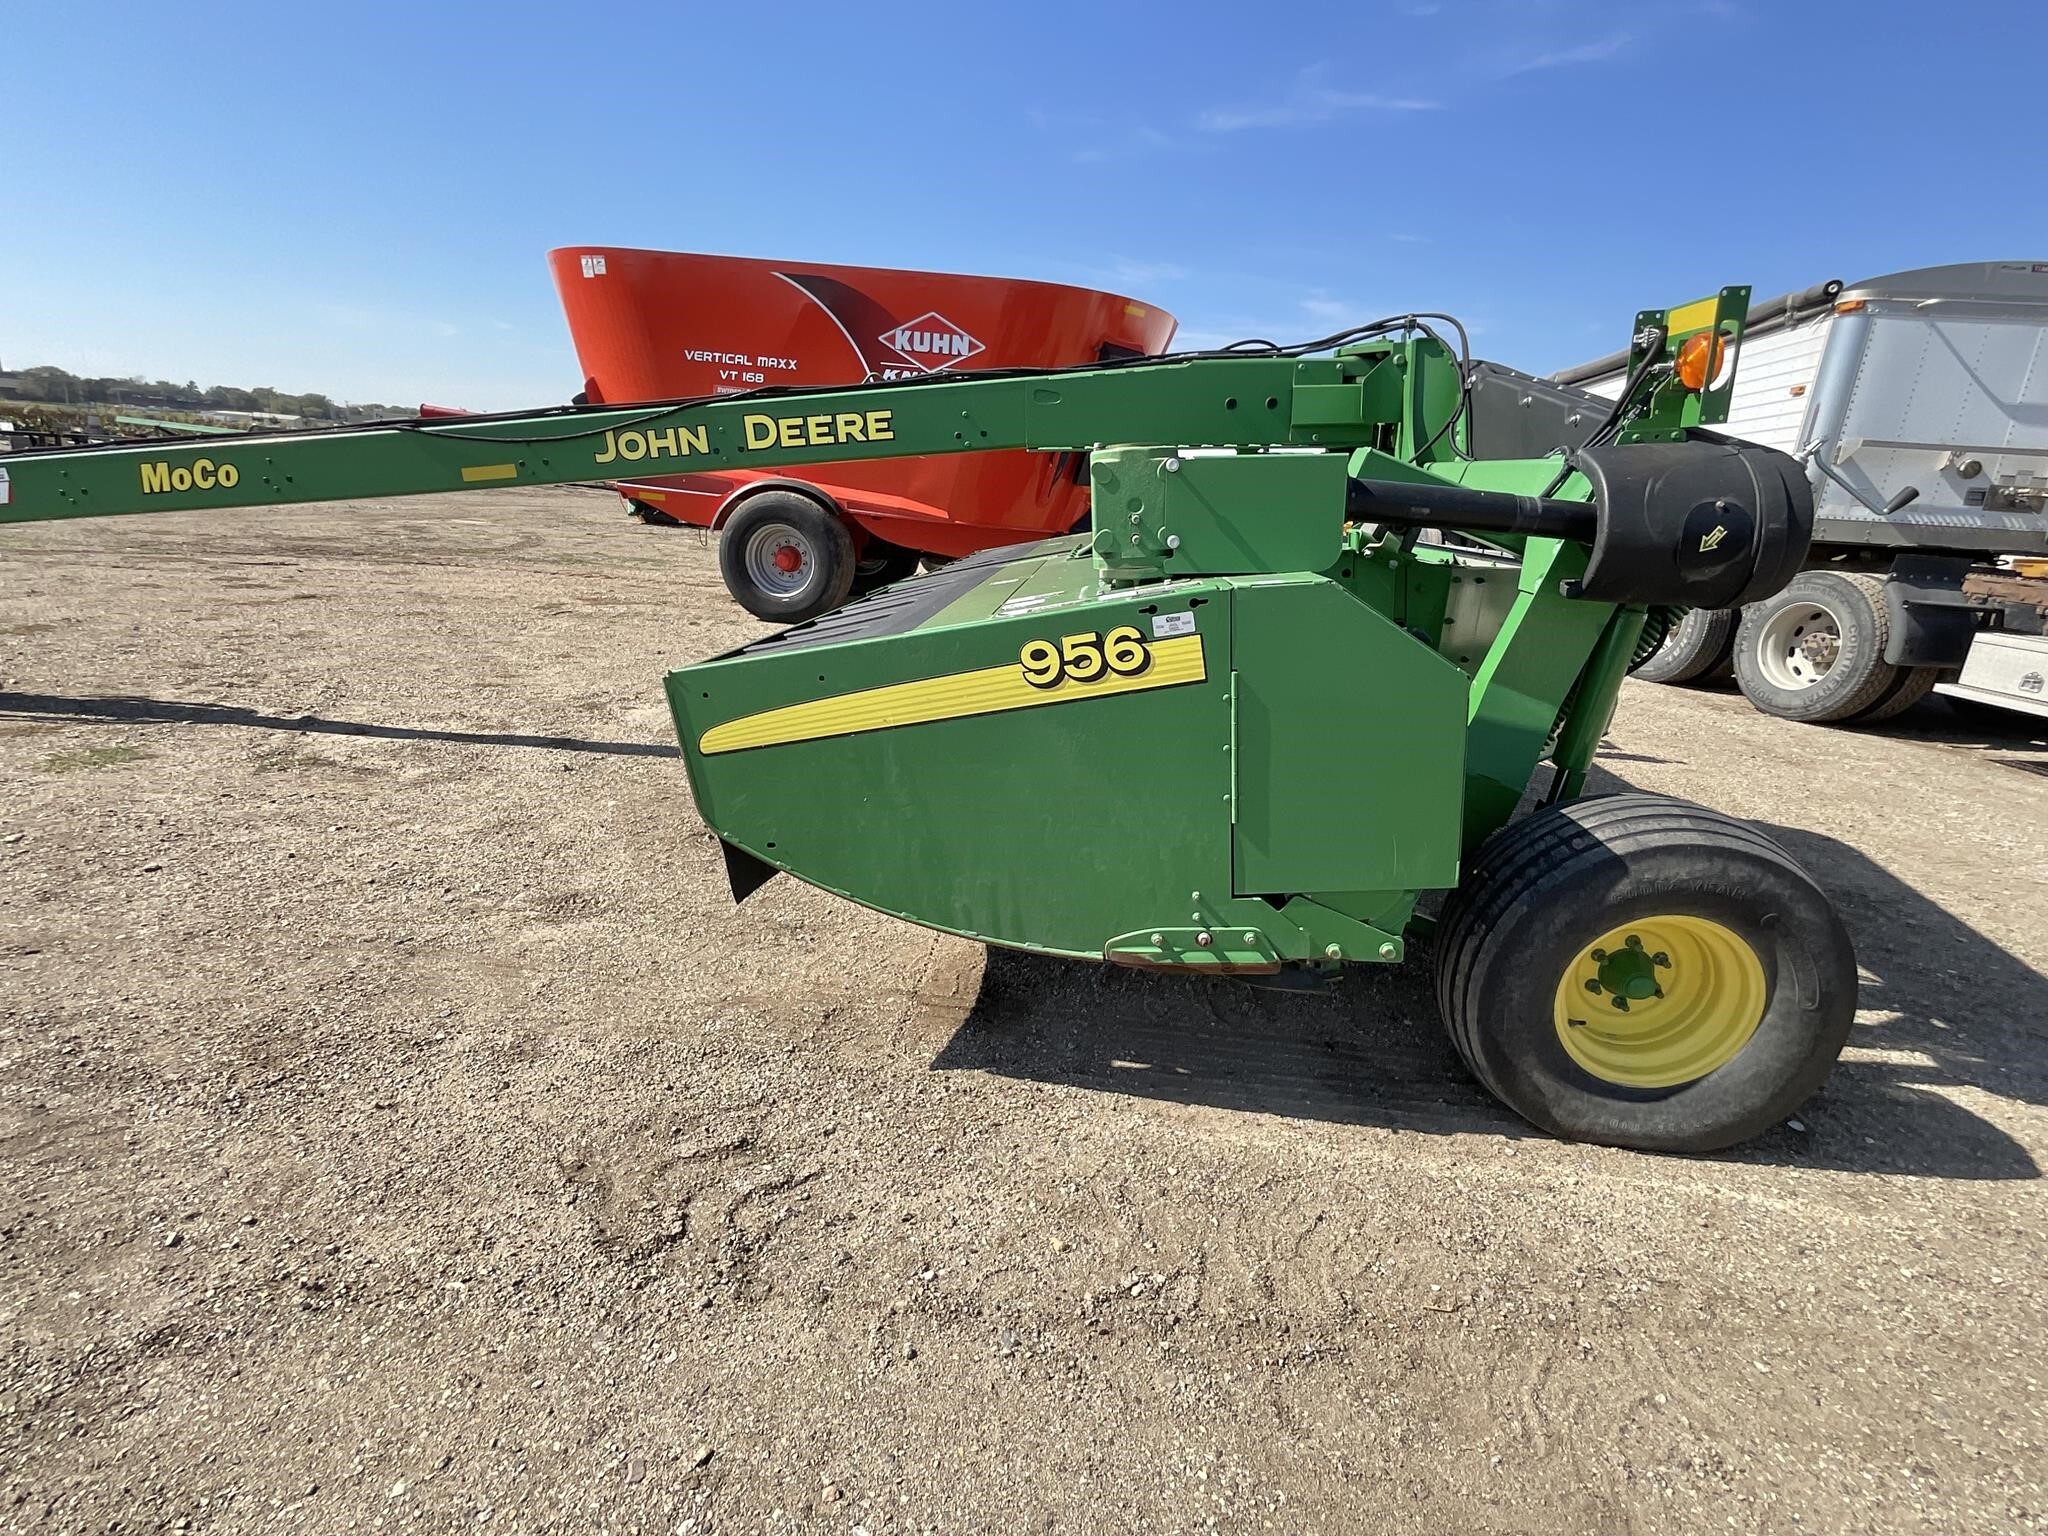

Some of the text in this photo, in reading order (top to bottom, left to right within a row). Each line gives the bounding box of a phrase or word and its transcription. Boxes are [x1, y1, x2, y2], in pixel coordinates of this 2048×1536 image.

[895, 329, 970, 356] KUHN
[684, 349, 797, 370] VERTICAL MAXX
[719, 369, 765, 383] VT 168
[593, 409, 895, 463] JOHN DEERE
[139, 457, 239, 494] MoCo
[1020, 625, 1152, 689] 956
